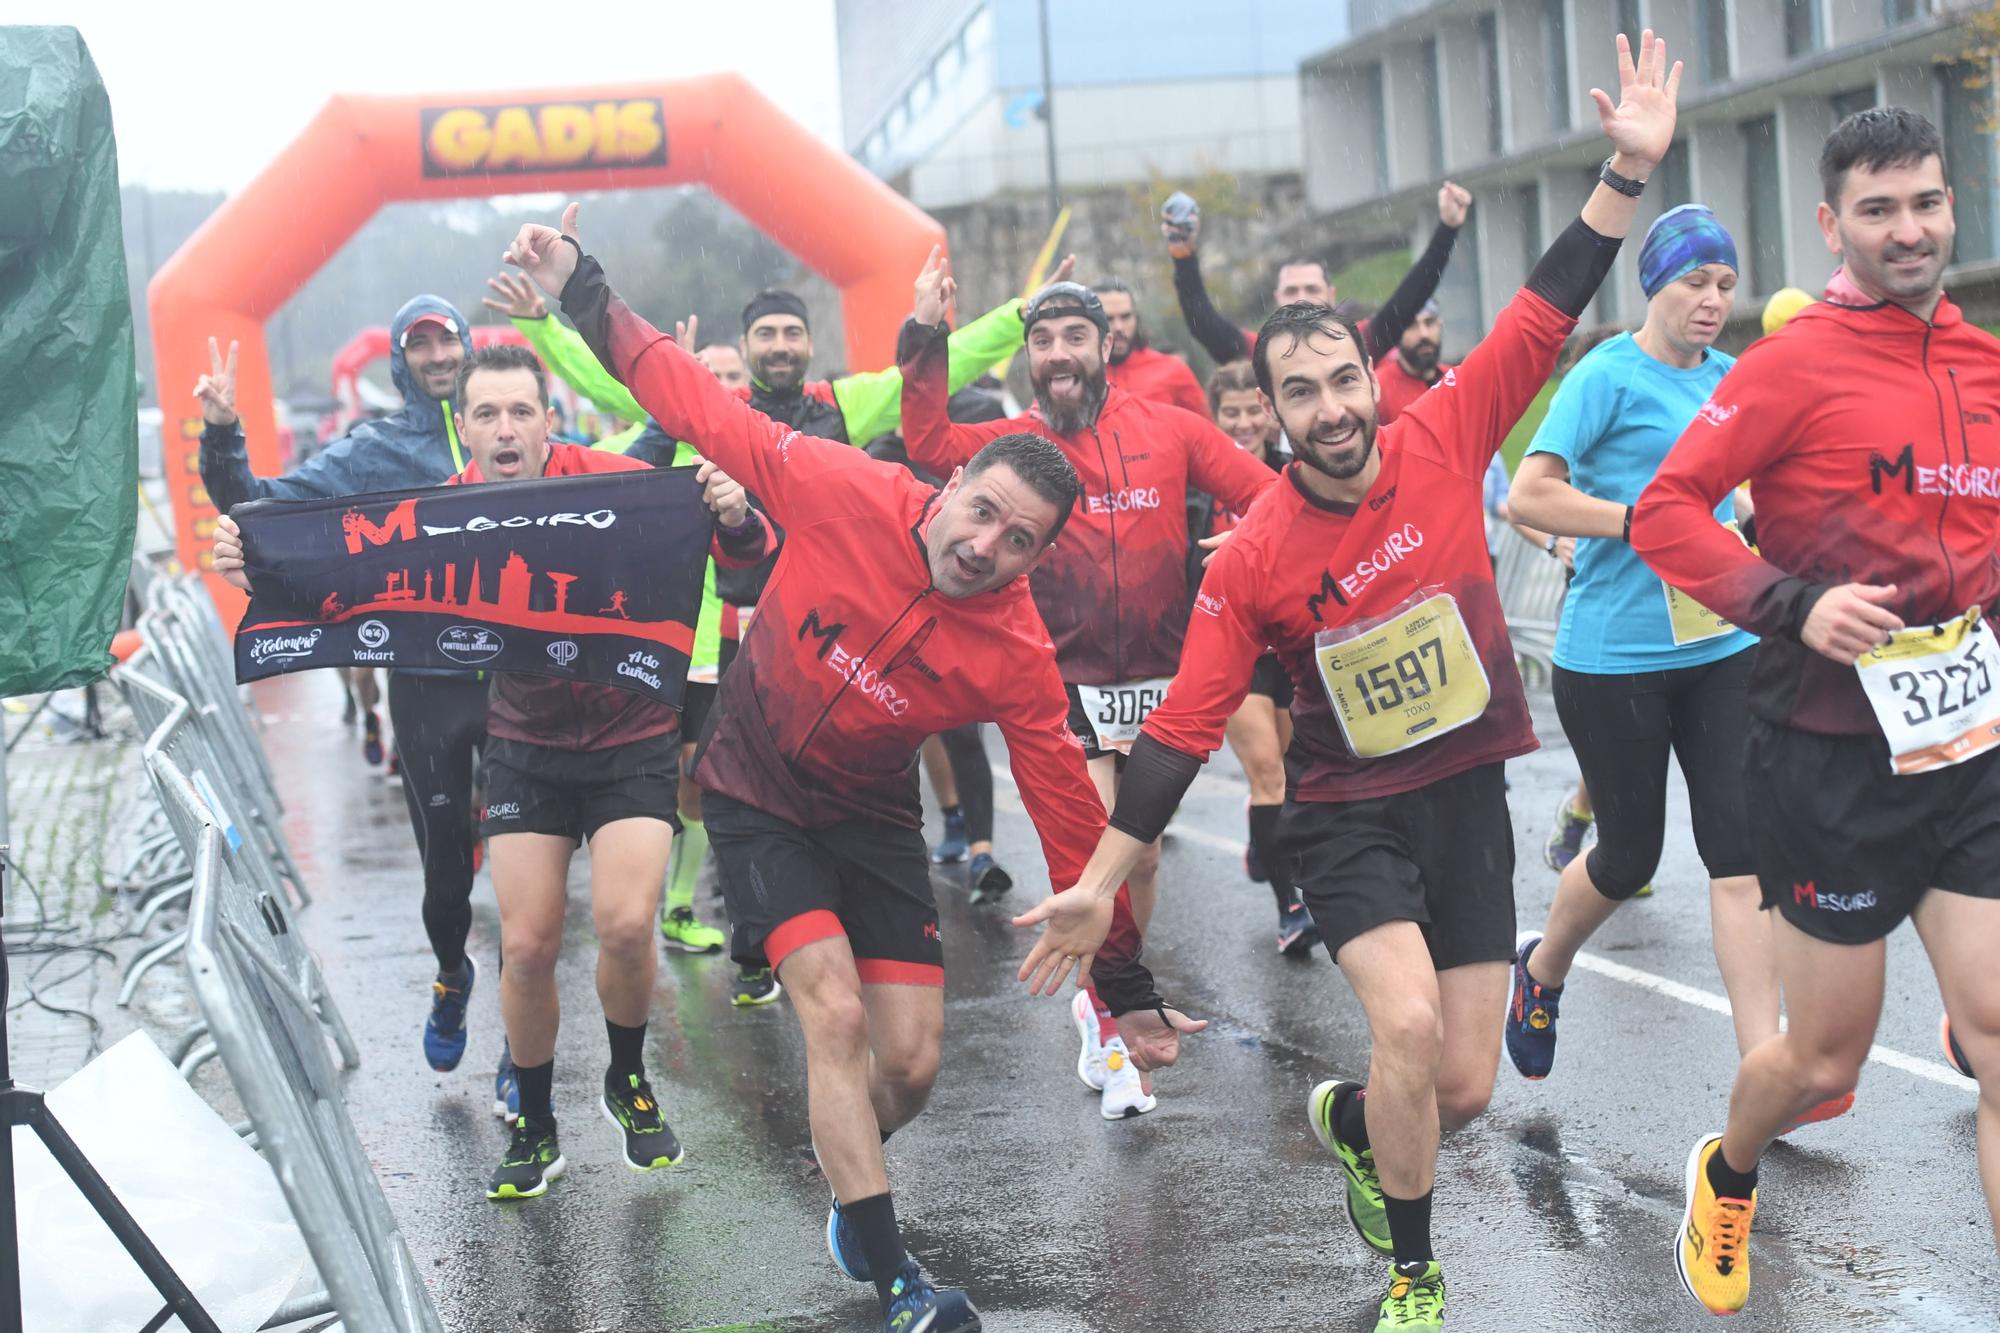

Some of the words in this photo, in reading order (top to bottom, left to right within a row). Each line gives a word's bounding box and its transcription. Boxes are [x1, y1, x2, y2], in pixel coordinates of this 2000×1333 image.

[431, 100, 662, 169] GADIS
[353, 650, 395, 661] Yakart
[617, 662, 662, 689] Cuñado
[1355, 637, 1448, 716] 1597
[1889, 642, 1991, 726] 3225
[1335, 687, 1350, 716] TANDA
[1404, 701, 1432, 718] TOXO
